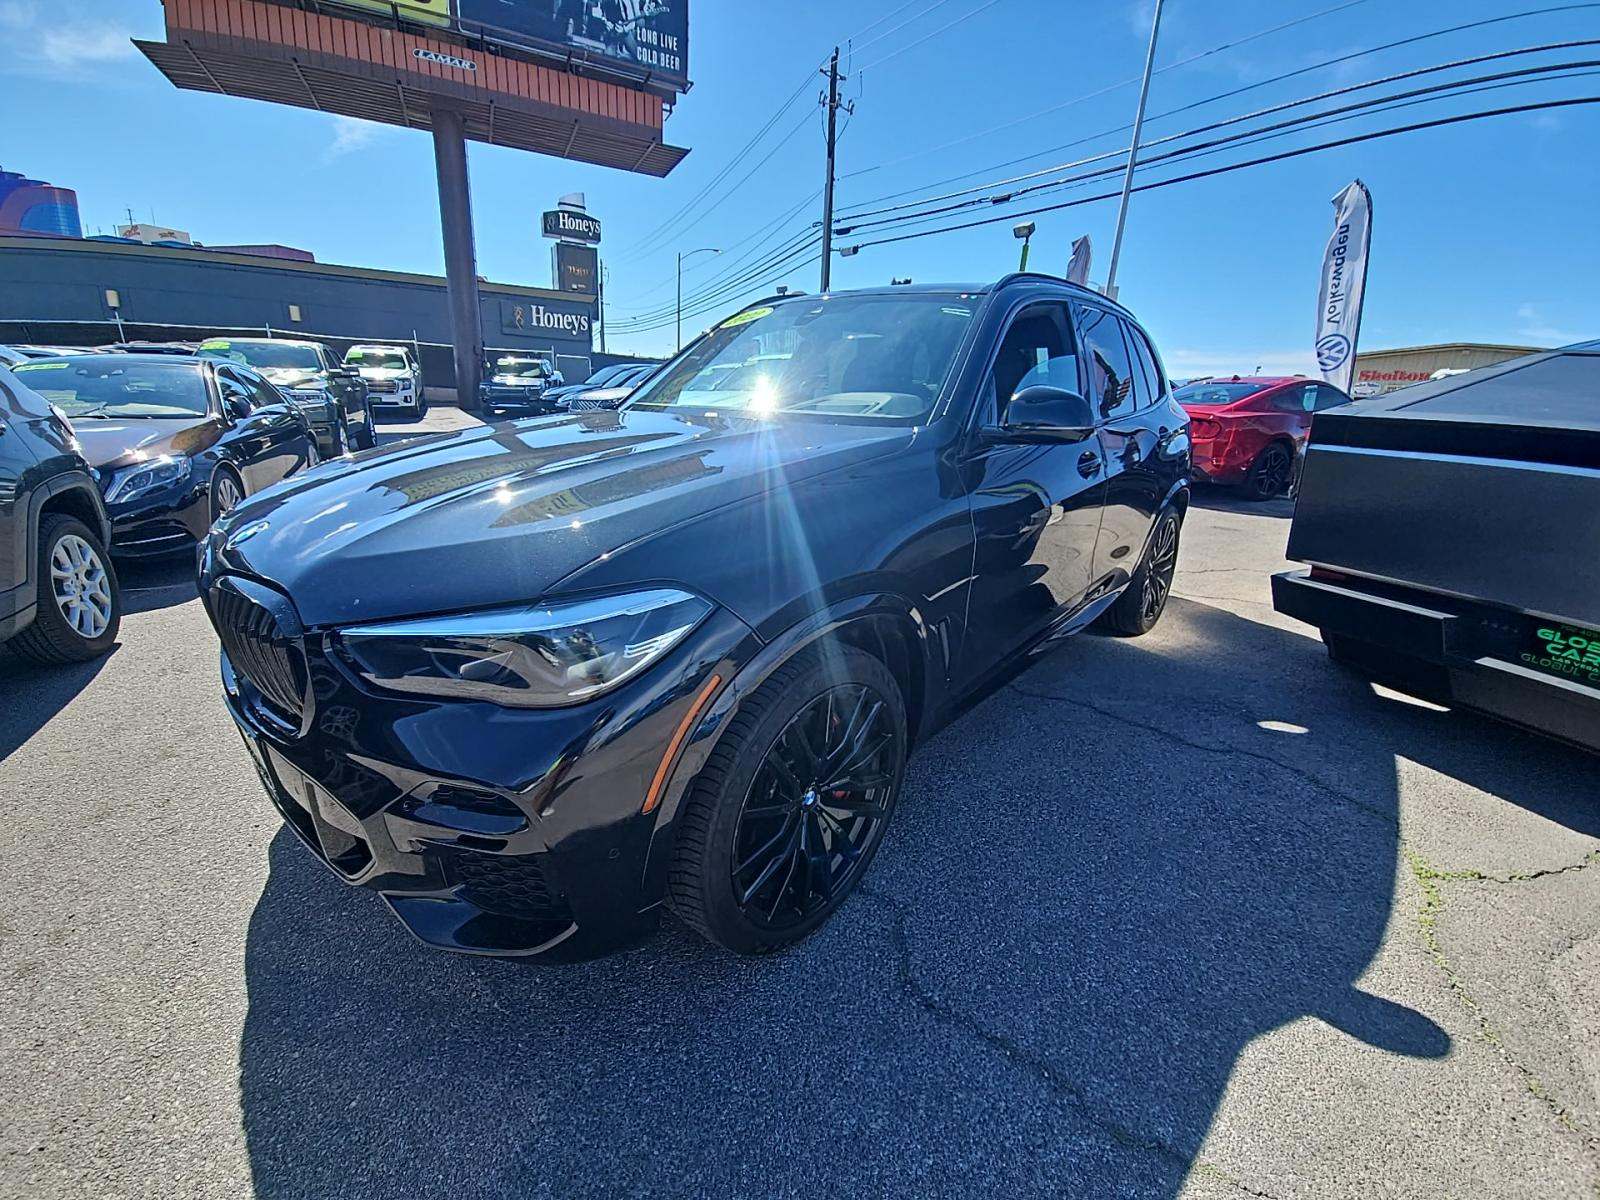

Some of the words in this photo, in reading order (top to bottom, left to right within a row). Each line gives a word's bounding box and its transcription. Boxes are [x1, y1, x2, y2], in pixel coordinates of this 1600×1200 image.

[637, 26, 658, 46] LONG
[660, 33, 678, 51] LIVE
[418, 50, 471, 70] LAMAR
[636, 46, 658, 65] COLD
[660, 52, 680, 71] BEER
[558, 212, 601, 236] Honeys
[530, 304, 589, 336] Honeys
